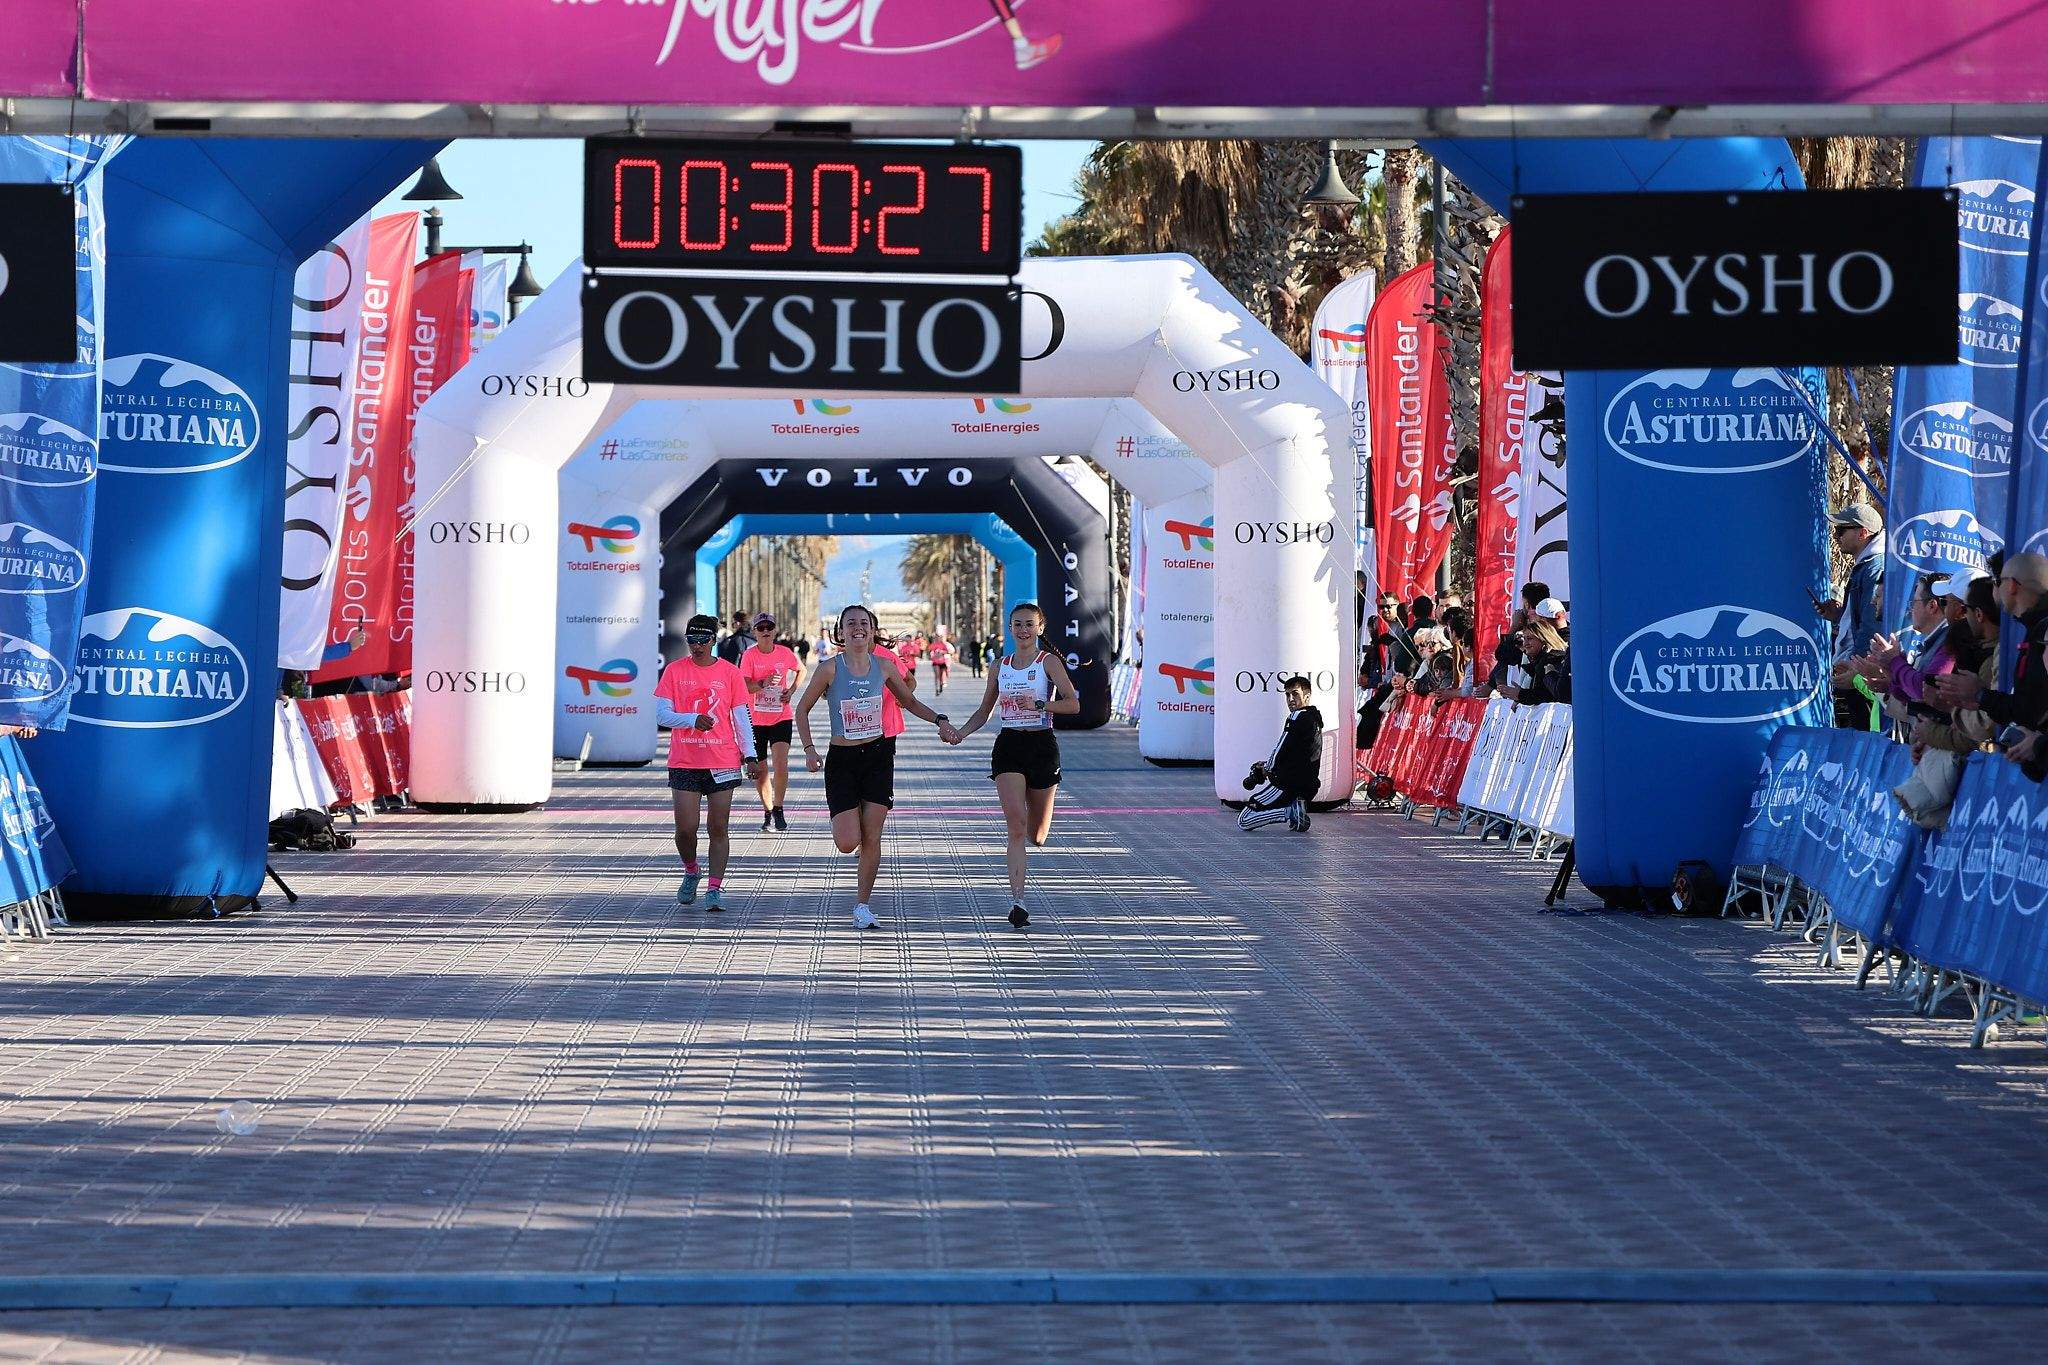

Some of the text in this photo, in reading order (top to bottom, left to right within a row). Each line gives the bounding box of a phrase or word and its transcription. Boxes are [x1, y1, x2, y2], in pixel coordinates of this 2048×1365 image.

[613, 158, 990, 255] 00:30:27
[1583, 250, 1895, 319] OYSHO
[603, 289, 1001, 379] OYSHO
[350, 271, 391, 469] Santander
[1172, 369, 1281, 393] OYSHO
[481, 375, 589, 398] OYSHO
[165, 396, 242, 412] LECHERA
[1395, 320, 1422, 488] Santander
[1653, 396, 1731, 409] CENTRAL
[771, 423, 860, 437] TotalEnergies
[951, 421, 1040, 434] TotalEnergies
[1618, 401, 1811, 444] ASTURIANA
[41, 439, 91, 453] LECHERA
[755, 466, 973, 487] VOLVO
[430, 521, 530, 545] OYSHO
[1234, 521, 1335, 544] OYSHO
[567, 560, 641, 573] TotalEnergies
[332, 530, 376, 646] Sports
[566, 614, 640, 624] totalenergies.es
[1064, 551, 1080, 699] OLVO
[155, 650, 230, 664] LECHERA
[1658, 645, 1808, 658] CENTRAL LECHERA
[426, 670, 526, 693] OYSHO
[1624, 650, 1814, 693] ASTURIANA
[564, 703, 638, 717] TotalEnergies
